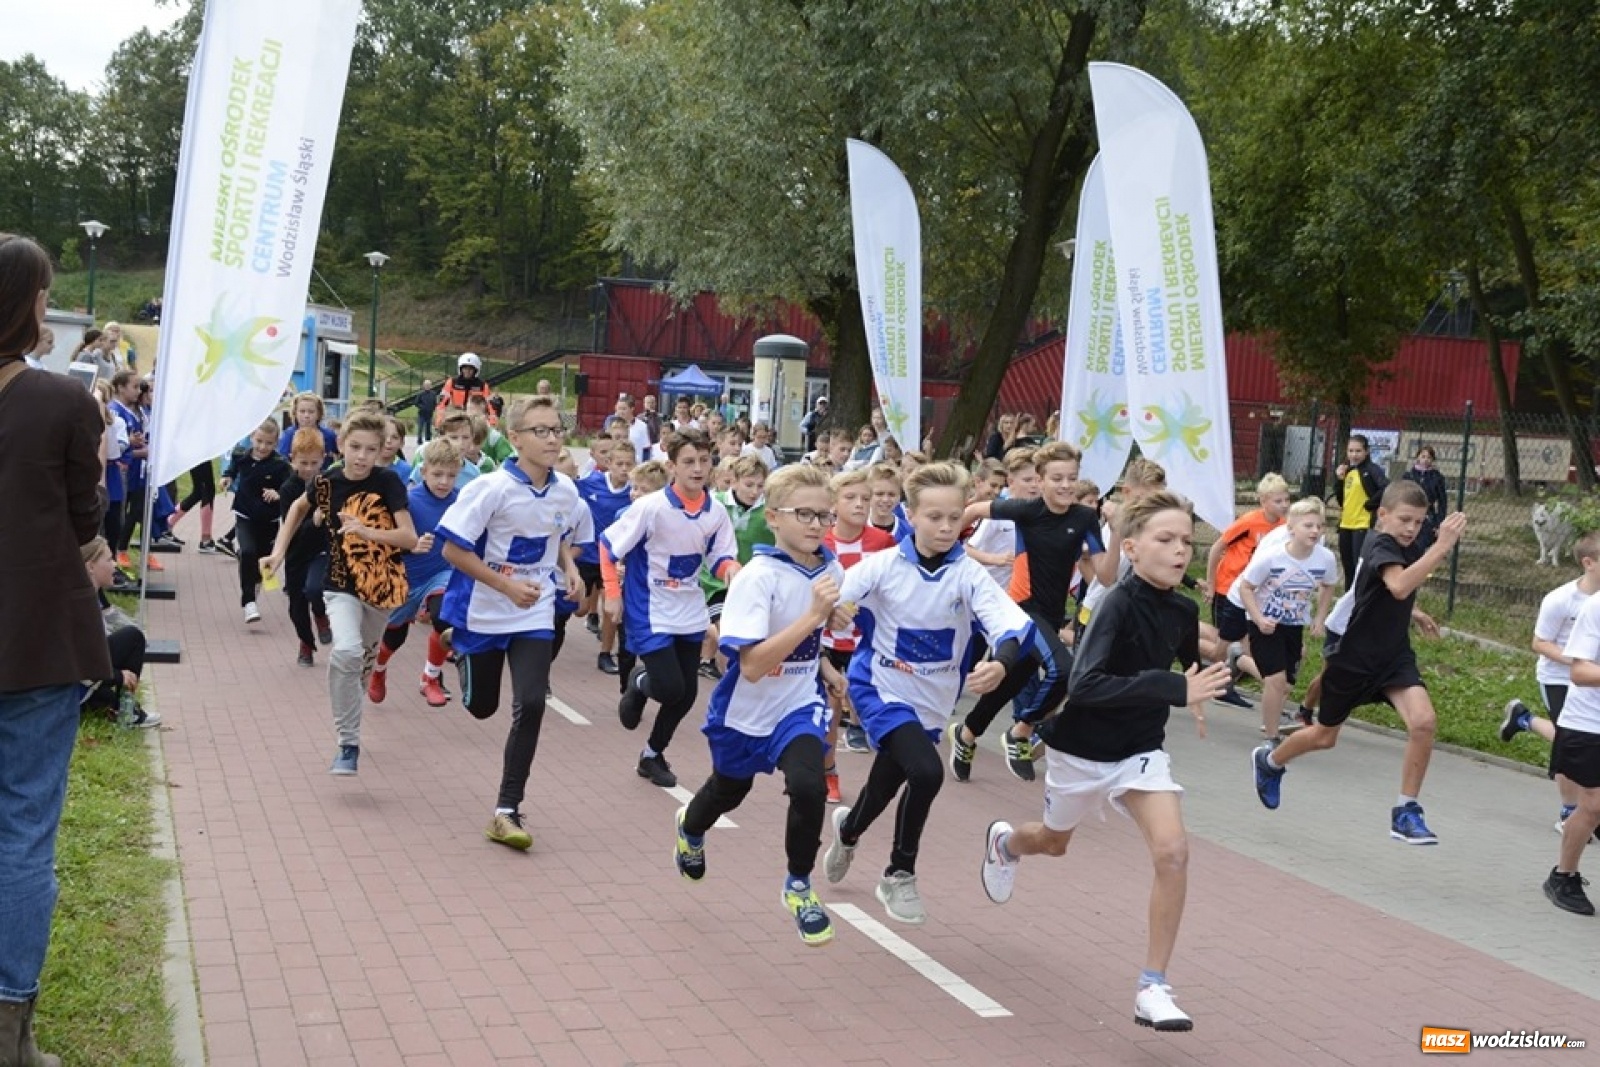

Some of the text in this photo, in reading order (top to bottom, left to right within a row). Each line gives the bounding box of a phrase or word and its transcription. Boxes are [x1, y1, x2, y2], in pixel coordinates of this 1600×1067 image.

[209, 56, 254, 262] MIEJSKI OŚRODEK
[223, 38, 283, 270] SPORTU I REKREACJI
[251, 159, 288, 274] CENTRUM
[276, 136, 316, 278] Wodzisław Śląski
[1086, 239, 1107, 371] MIEJSKI OŚRODEK
[1096, 314, 1113, 374] SPORTU
[1139, 756, 1150, 774] 7
